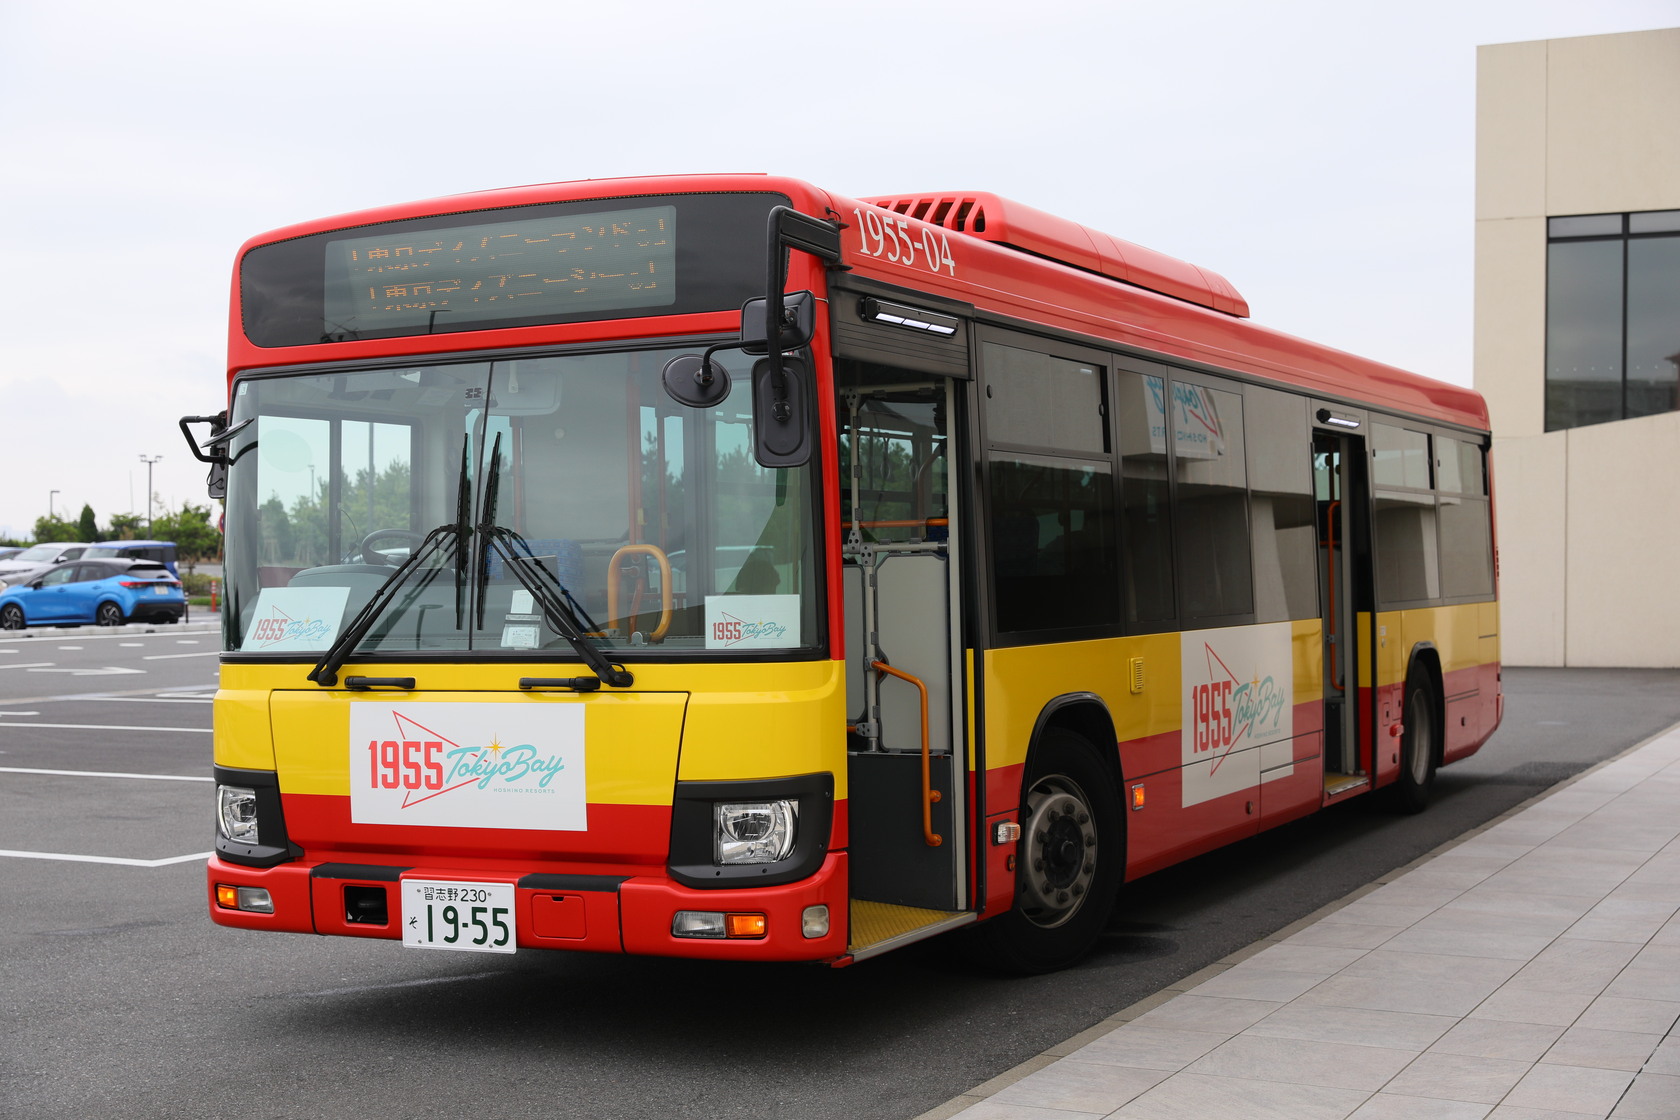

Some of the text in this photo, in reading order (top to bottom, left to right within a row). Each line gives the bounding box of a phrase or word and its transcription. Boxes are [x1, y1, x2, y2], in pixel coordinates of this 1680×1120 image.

[854, 207, 956, 277] 1955-04
[252, 618, 288, 640] 1955
[713, 621, 741, 640] 1955
[1192, 680, 1232, 753] 1955
[368, 740, 444, 790] 1955
[427, 904, 510, 947] 19-55
